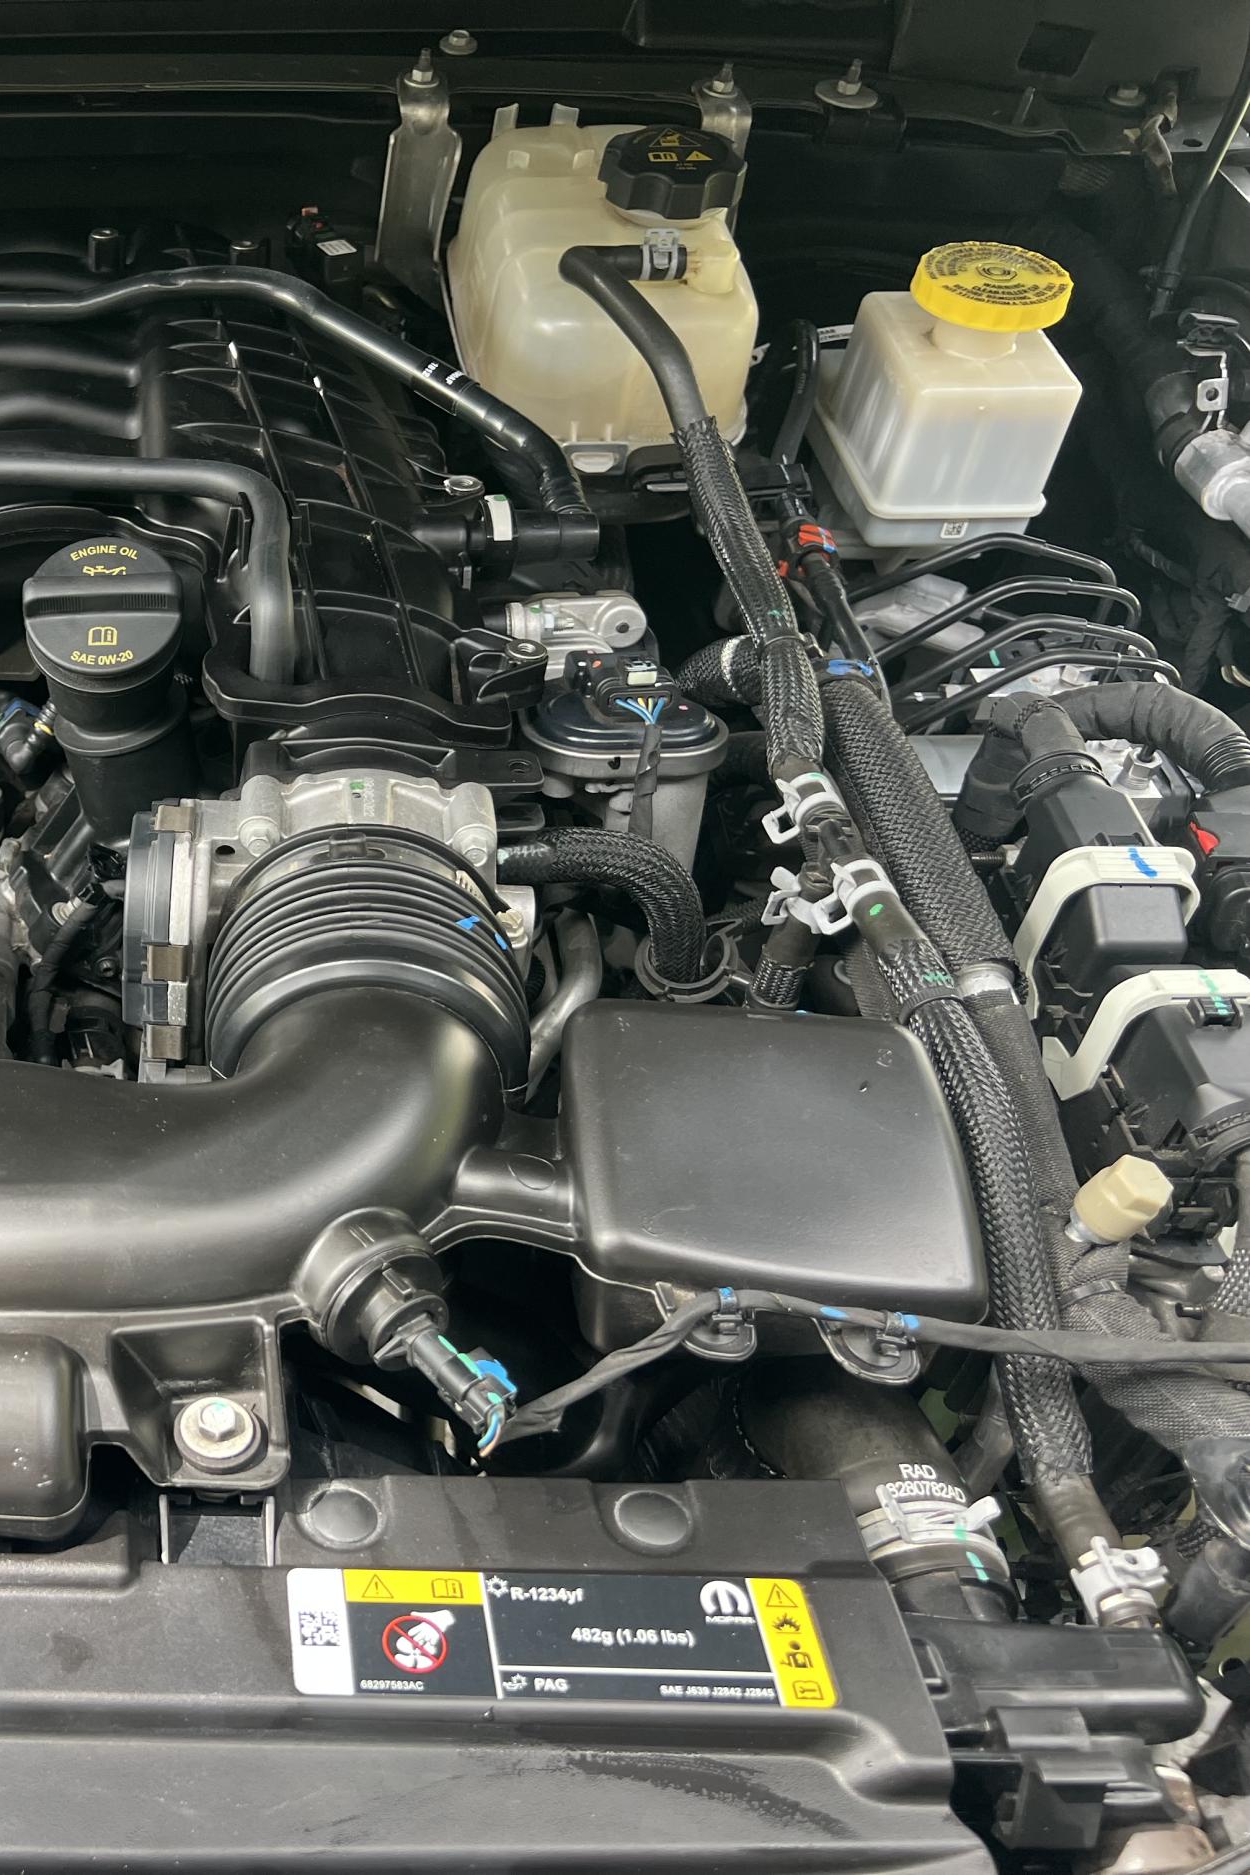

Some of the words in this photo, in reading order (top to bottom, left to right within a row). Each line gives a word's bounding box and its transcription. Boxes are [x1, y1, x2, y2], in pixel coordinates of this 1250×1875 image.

[70, 545, 117, 561] ENGINE
[119, 546, 139, 560] OIL
[70, 650, 96, 665] SAE
[98, 650, 134, 665] 0W-20
[898, 1463, 937, 1480] RAD
[510, 1586, 584, 1605] R-1234yf
[571, 1626, 614, 1646] 482g
[616, 1628, 658, 1647] (1.06
[661, 1629, 697, 1648] lbs)
[534, 1678, 570, 1692] PAG
[659, 1684, 683, 1697] SAE
